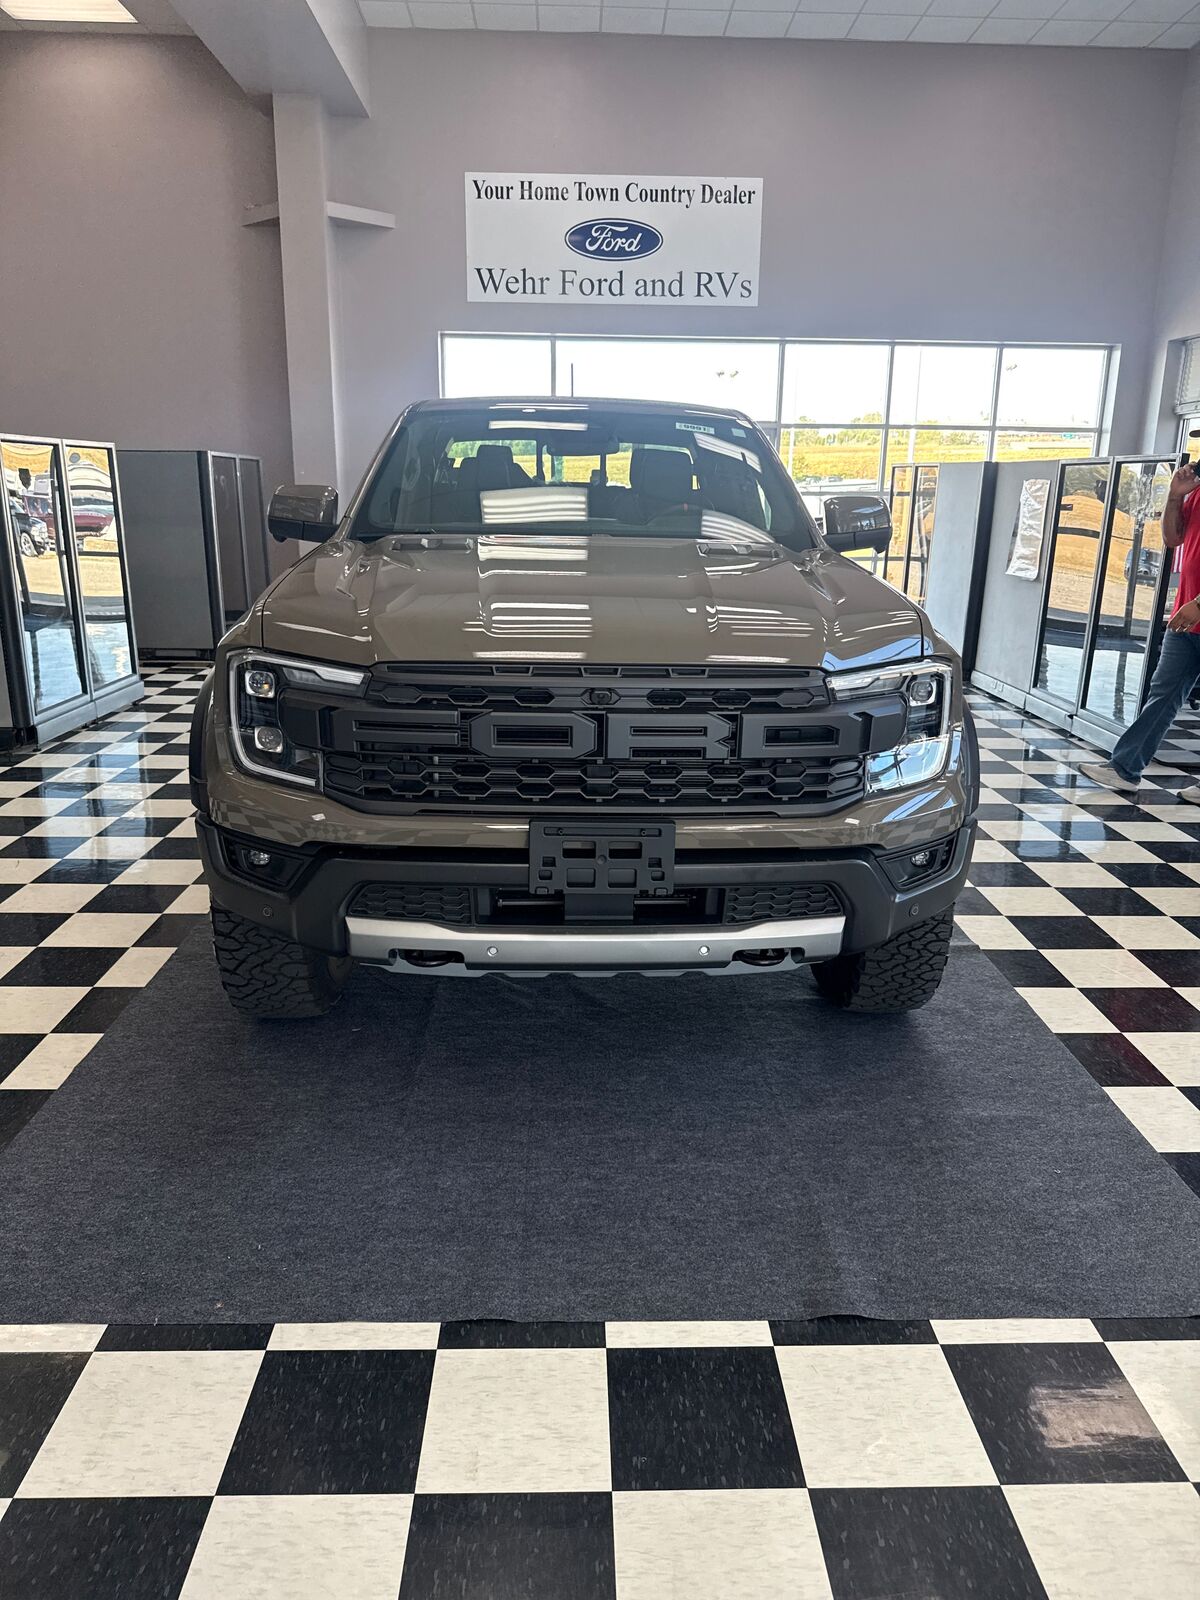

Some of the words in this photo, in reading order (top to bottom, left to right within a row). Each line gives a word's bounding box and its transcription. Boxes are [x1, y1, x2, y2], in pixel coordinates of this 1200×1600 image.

[471, 179, 514, 200] Your
[519, 180, 569, 201] Home
[573, 181, 620, 202] Town
[624, 182, 696, 208] Country
[700, 184, 756, 205] Dealer
[585, 224, 643, 252] Ford
[474, 267, 550, 295] Wehr
[558, 269, 625, 297] Ford
[634, 270, 685, 298] and
[693, 271, 752, 299] RVs
[332, 708, 867, 760] FORD
